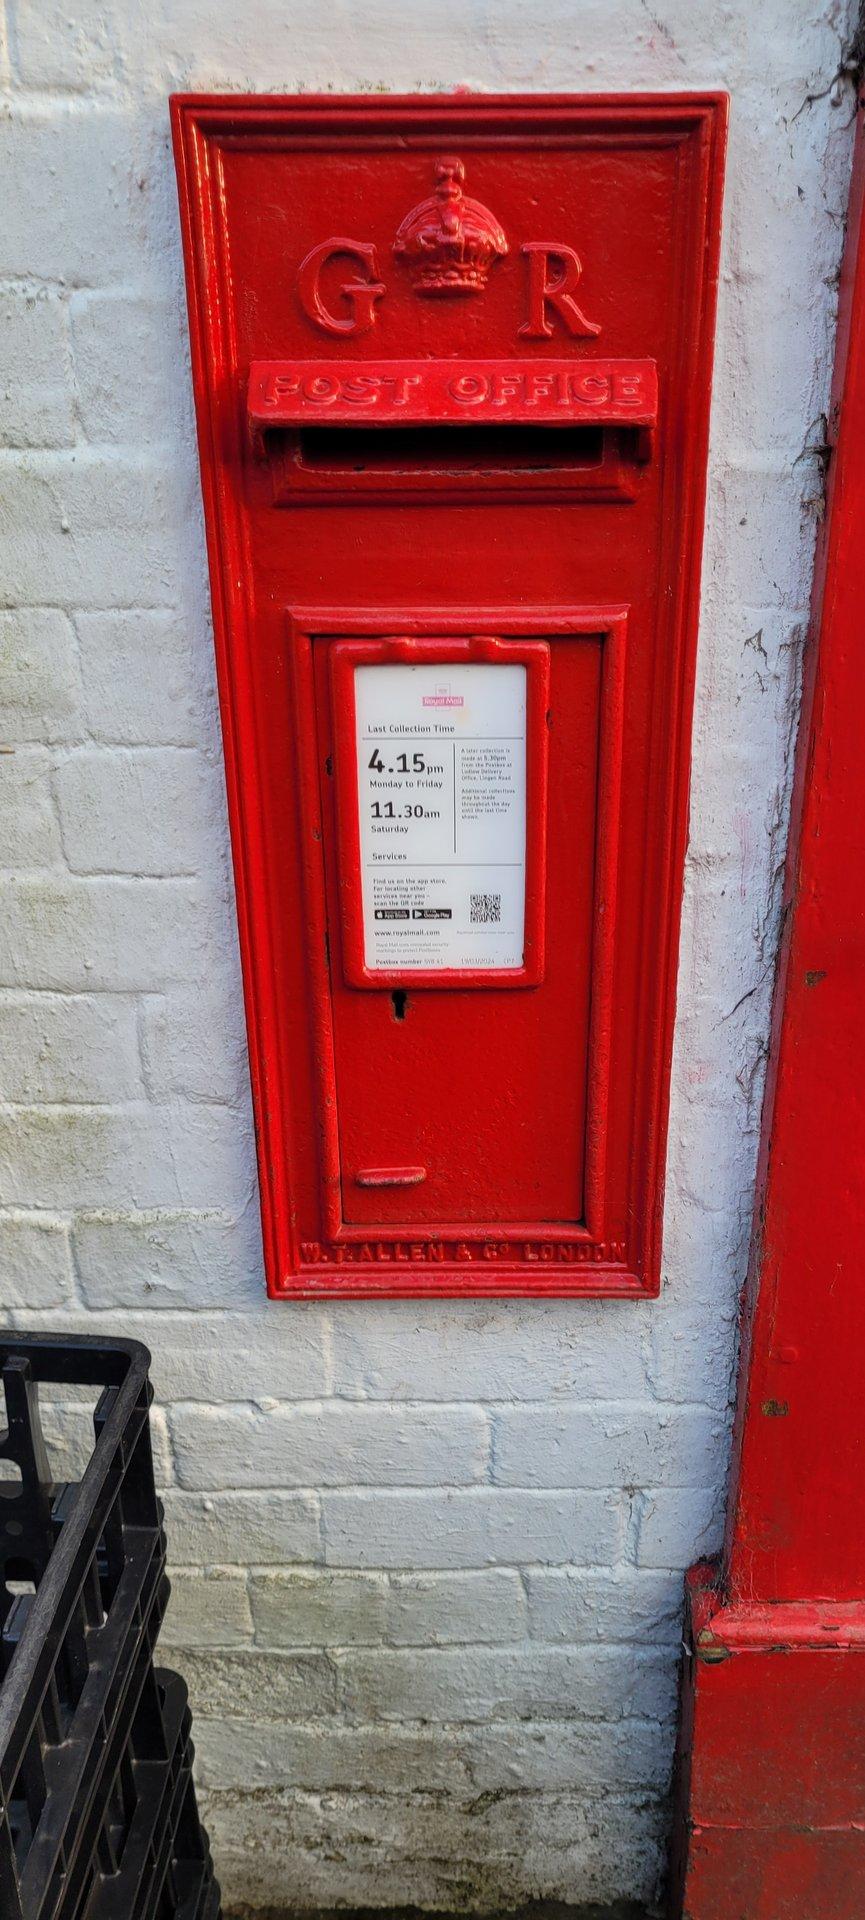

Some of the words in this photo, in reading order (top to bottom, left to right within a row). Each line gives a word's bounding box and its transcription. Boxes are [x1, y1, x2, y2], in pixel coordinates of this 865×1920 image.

[299, 236, 386, 336] G
[517, 242, 602, 339] R
[264, 373, 422, 407] POST
[448, 372, 643, 407] OFFICE
[424, 697, 445, 706] Royal
[446, 697, 462, 705] Mail
[368, 724, 386, 733] Last
[389, 724, 431, 733] Collection
[434, 724, 455, 733] Time
[370, 780, 402, 788] Monday
[417, 780, 443, 789] Friday
[371, 826, 409, 834] Saturday
[372, 852, 408, 860] Services
[374, 928, 440, 936] www.royalmail.com
[456, 1243, 473, 1261] &
[523, 1240, 627, 1262] LONDON
